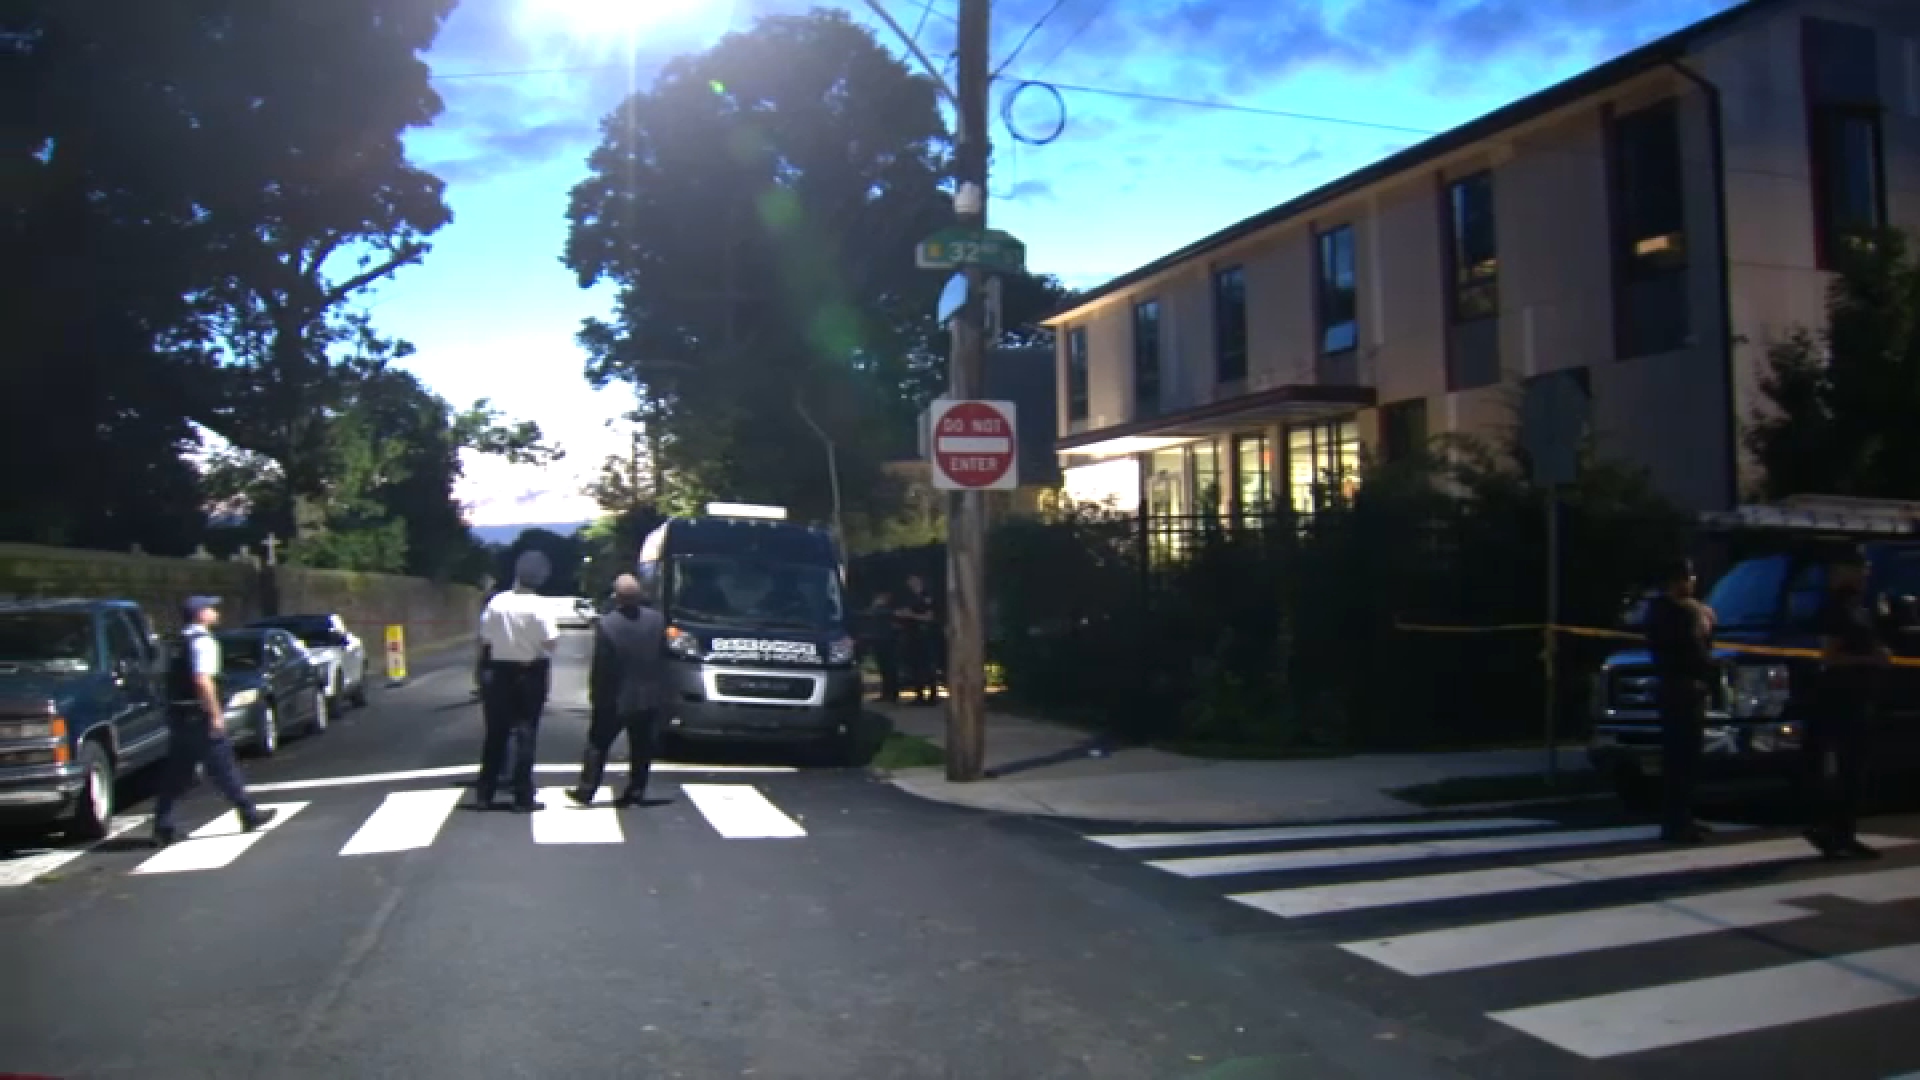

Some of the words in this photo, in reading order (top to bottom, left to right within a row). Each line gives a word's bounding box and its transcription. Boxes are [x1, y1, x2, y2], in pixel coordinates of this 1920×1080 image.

[943, 417, 964, 433] DO
[972, 418, 1001, 433] NOT
[950, 457, 997, 471] ENTER
